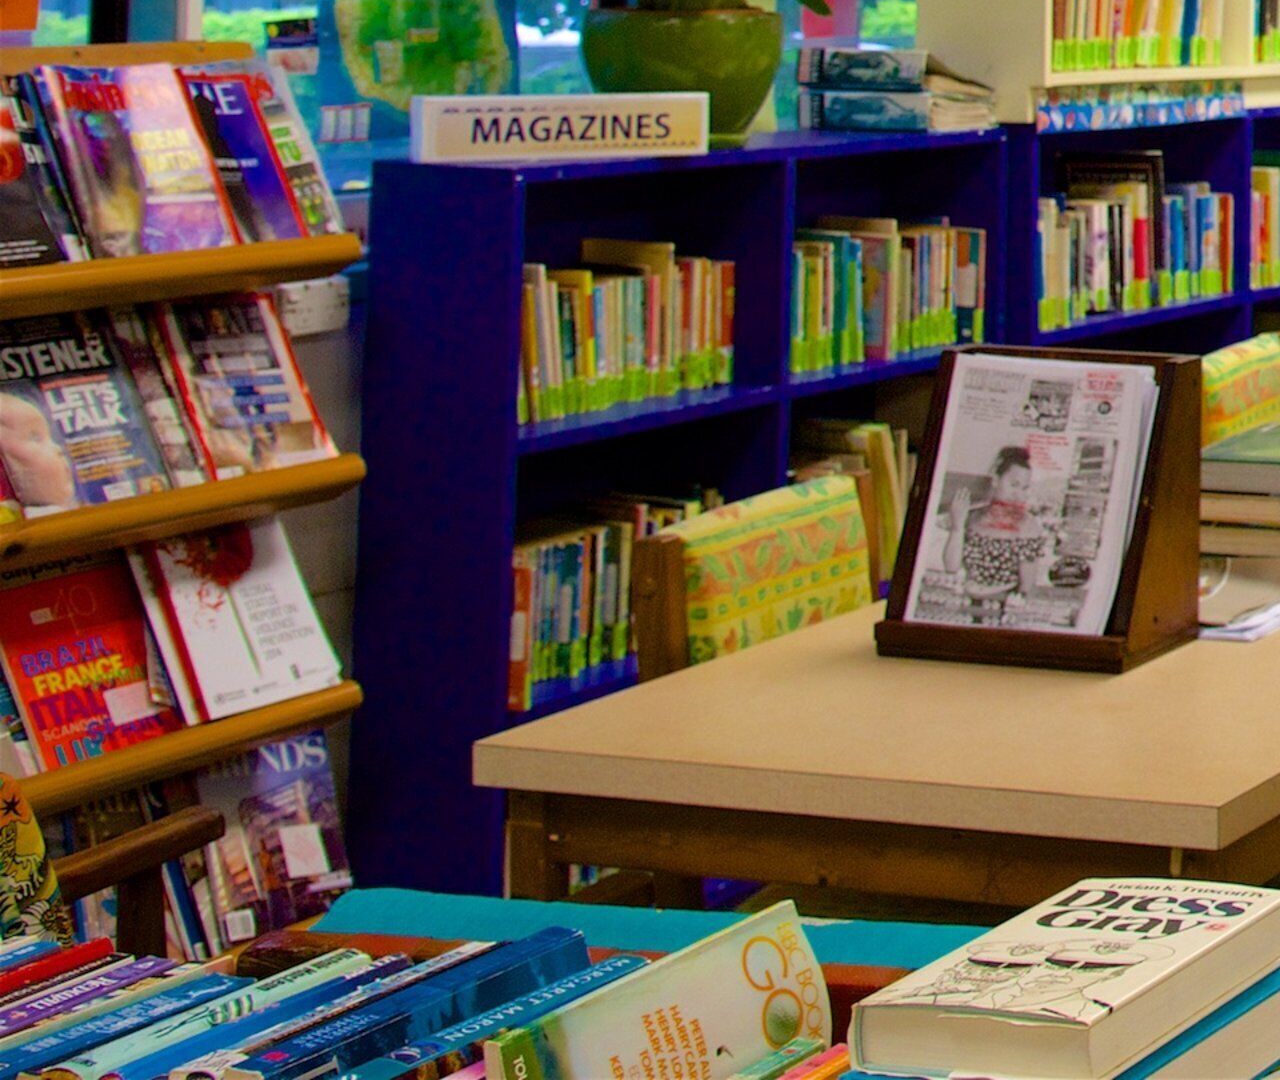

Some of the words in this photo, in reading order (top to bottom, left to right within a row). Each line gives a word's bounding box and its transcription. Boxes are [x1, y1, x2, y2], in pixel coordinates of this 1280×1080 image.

[472, 114, 671, 143] MAGAZINES
[43, 381, 119, 412] LET'S
[51, 401, 129, 435] TALK
[21, 637, 113, 677] BRAZIL
[33, 653, 123, 698] FRANCE
[30, 684, 110, 731] ITAL
[1051, 888, 1252, 917] Dress
[1036, 908, 1206, 940] Gray
[529, 957, 632, 1006] MARGARET
[443, 1003, 524, 1043] MARON
[641, 1013, 663, 1055] MARK
[655, 1008, 678, 1053] HENRY
[669, 1004, 691, 1050] HARRY
[689, 1018, 707, 1058] PETER
